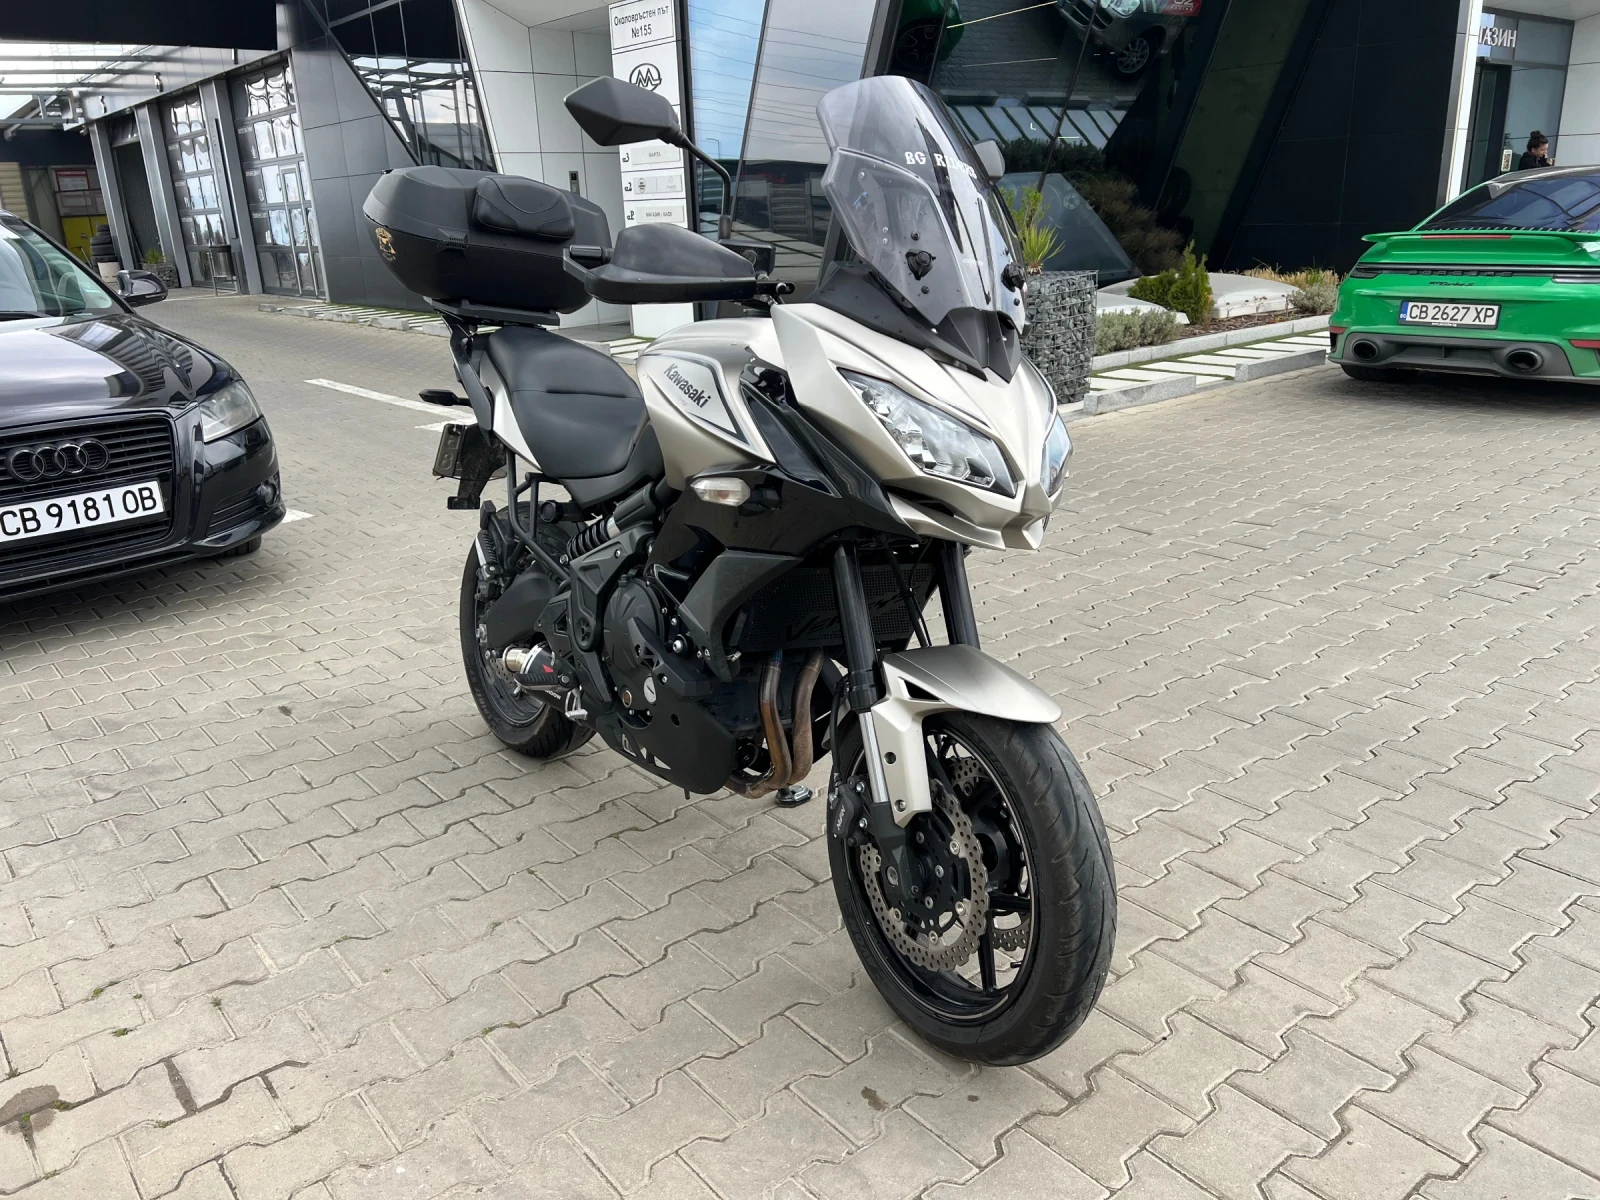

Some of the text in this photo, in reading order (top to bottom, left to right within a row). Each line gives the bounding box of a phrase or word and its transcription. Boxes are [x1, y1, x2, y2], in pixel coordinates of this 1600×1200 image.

[614, 5, 669, 26] Околовръстен път
[631, 23, 652, 38] №155
[904, 151, 927, 165] BG
[1408, 269, 1513, 277] PORSCHE
[1409, 304, 1429, 320] CB
[1431, 305, 1470, 322] 2627
[1472, 307, 1495, 323] XP
[663, 363, 711, 408] Kawasaki
[0, 486, 157, 536] CB 9181 OB
